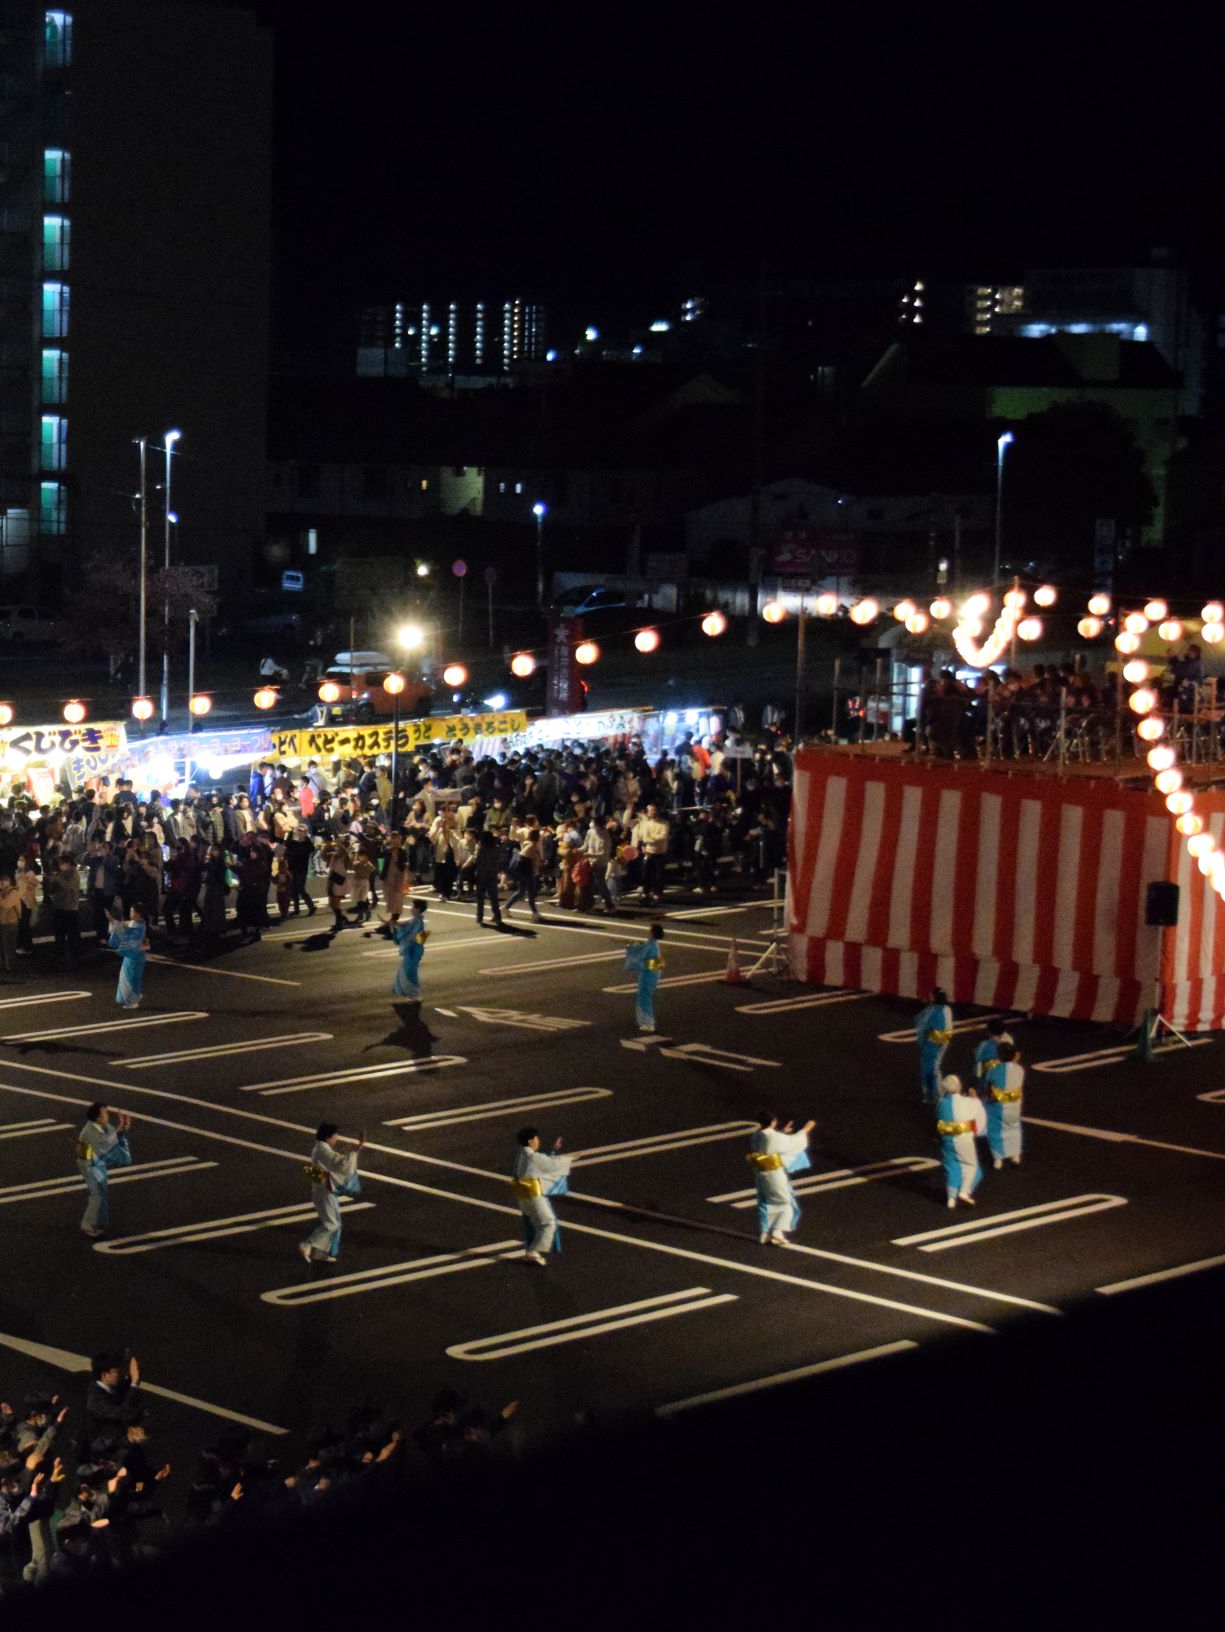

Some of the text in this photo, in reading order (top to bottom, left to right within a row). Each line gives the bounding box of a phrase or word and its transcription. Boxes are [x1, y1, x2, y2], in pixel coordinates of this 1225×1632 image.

[9, 728, 103, 754] くじびき
[308, 729, 410, 753] ベビーカステラ
